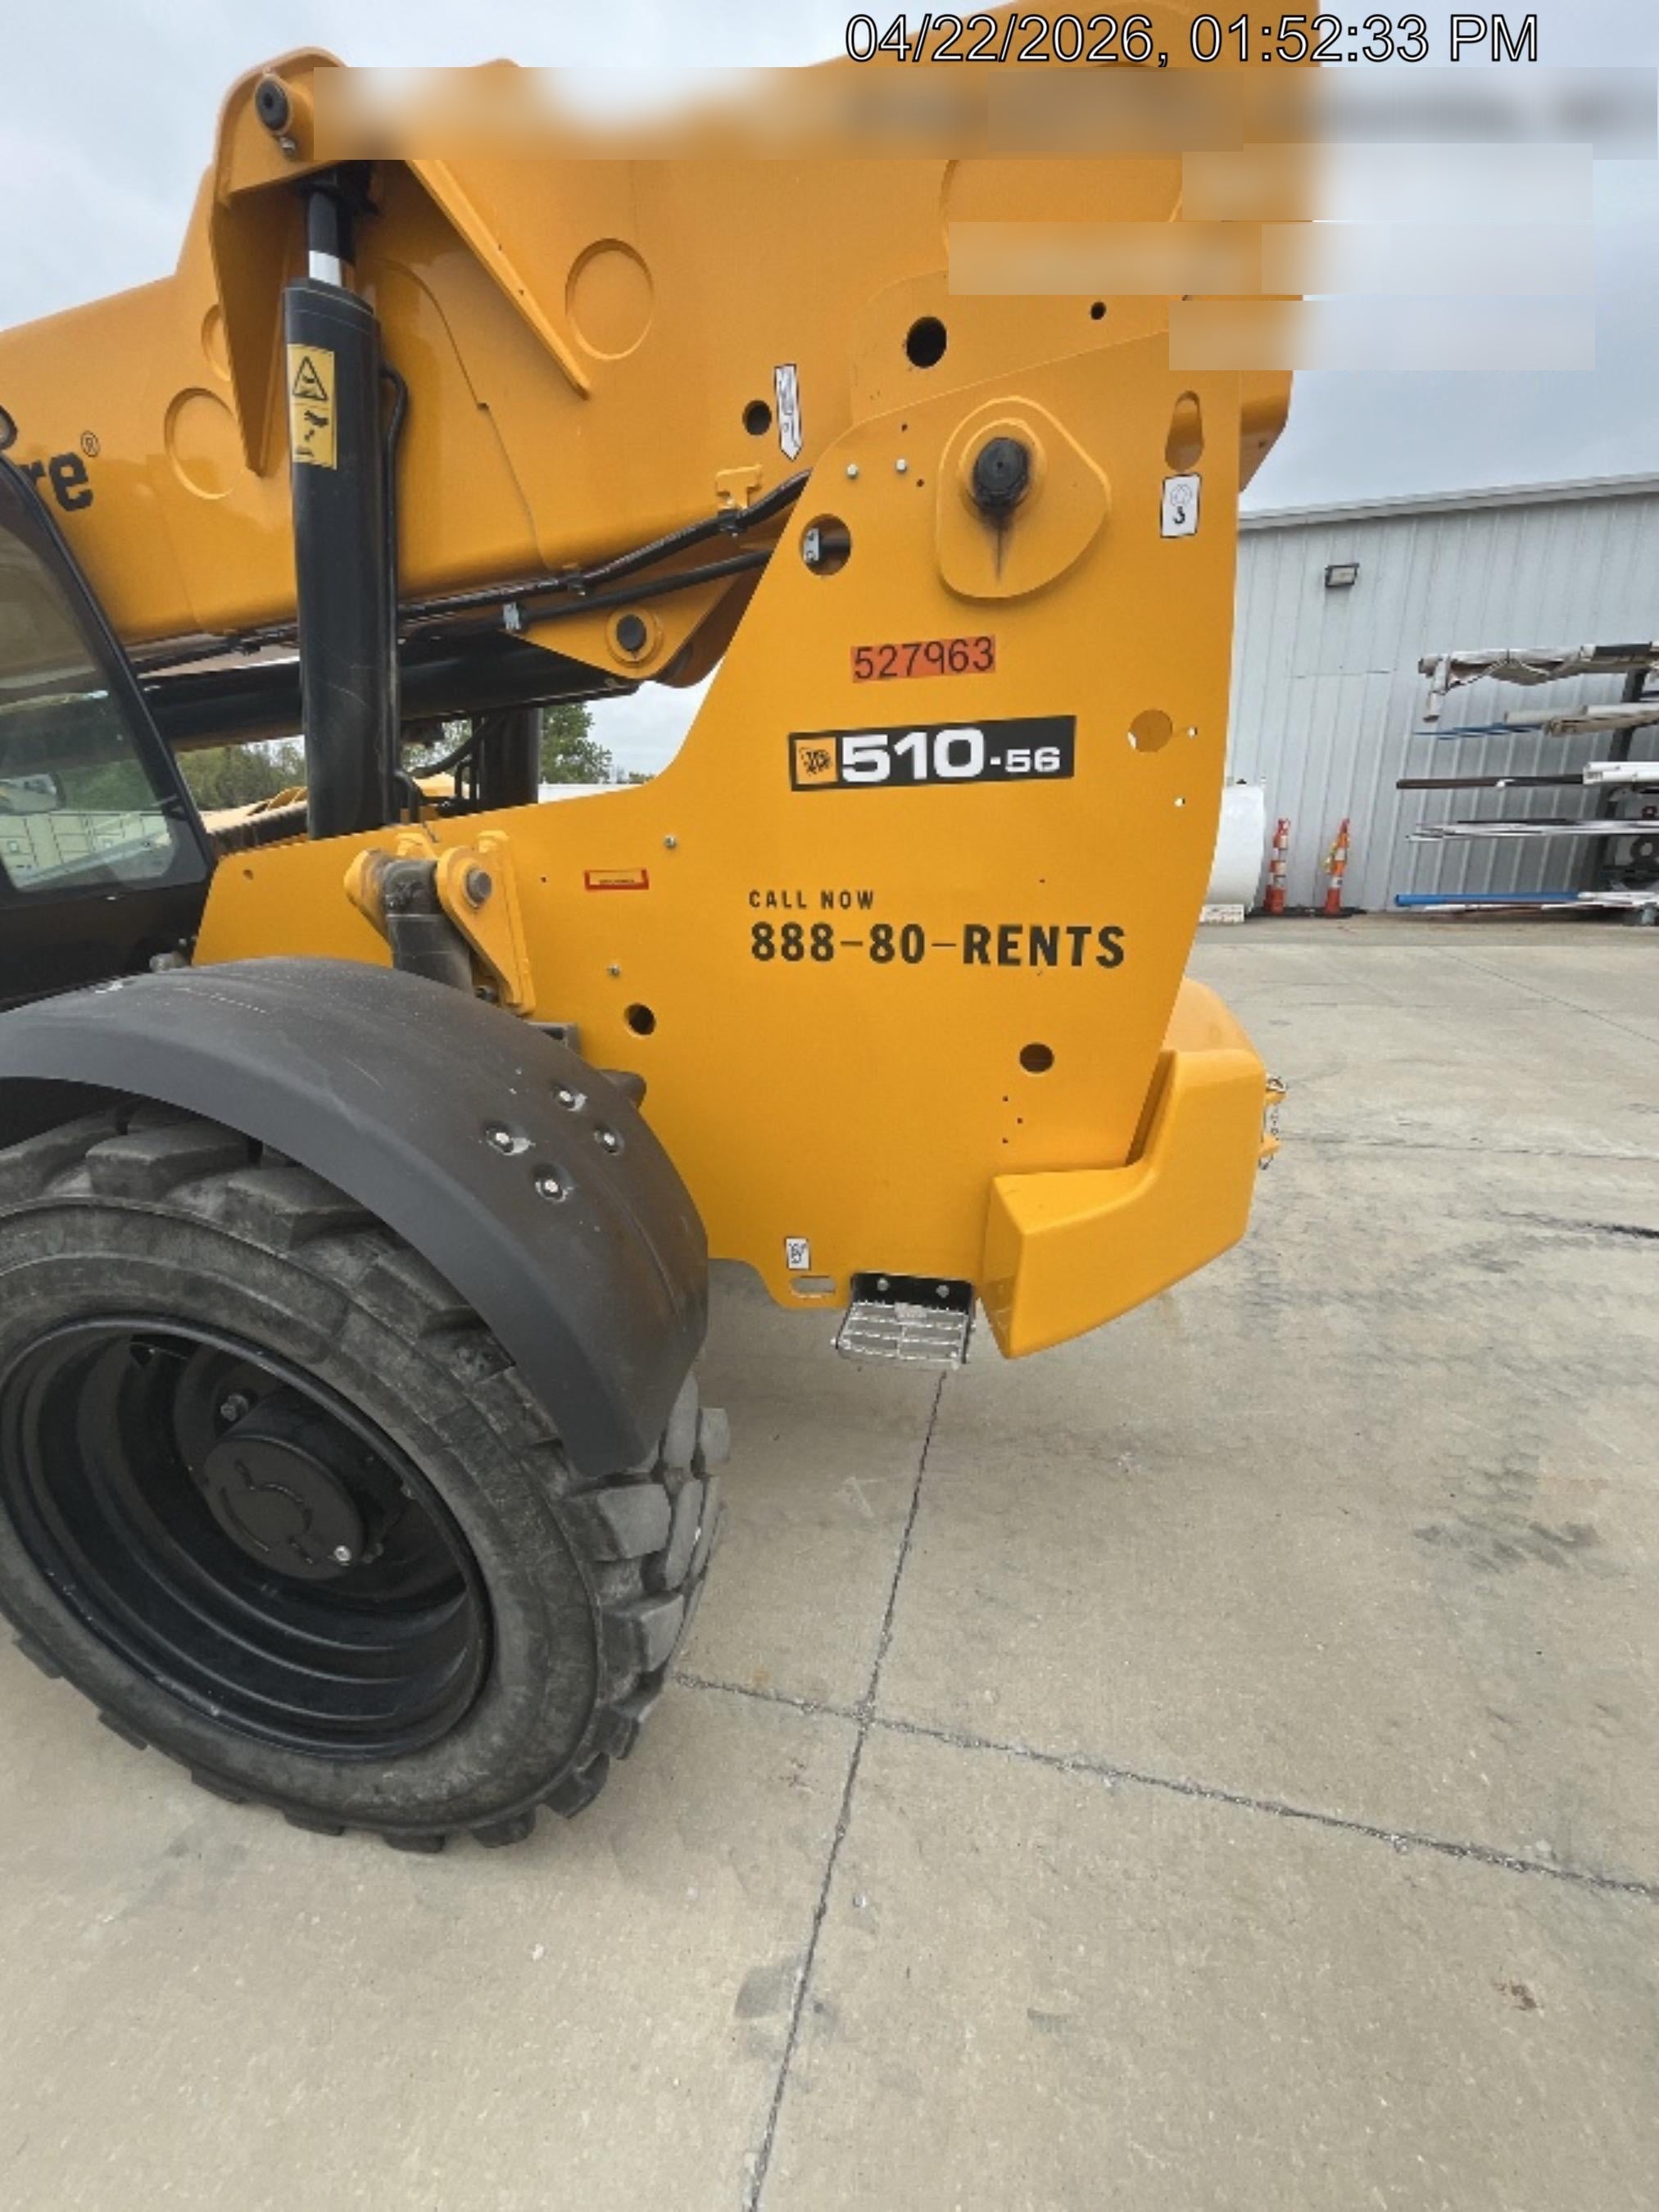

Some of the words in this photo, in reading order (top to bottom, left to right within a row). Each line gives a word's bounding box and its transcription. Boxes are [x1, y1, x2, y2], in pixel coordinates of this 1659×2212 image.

[854, 636, 994, 679] 527963
[841, 728, 1061, 782] 510-56
[749, 890, 807, 909] CALL
[821, 890, 874, 909] NOW
[750, 922, 1125, 968] 888-80-RENTS
